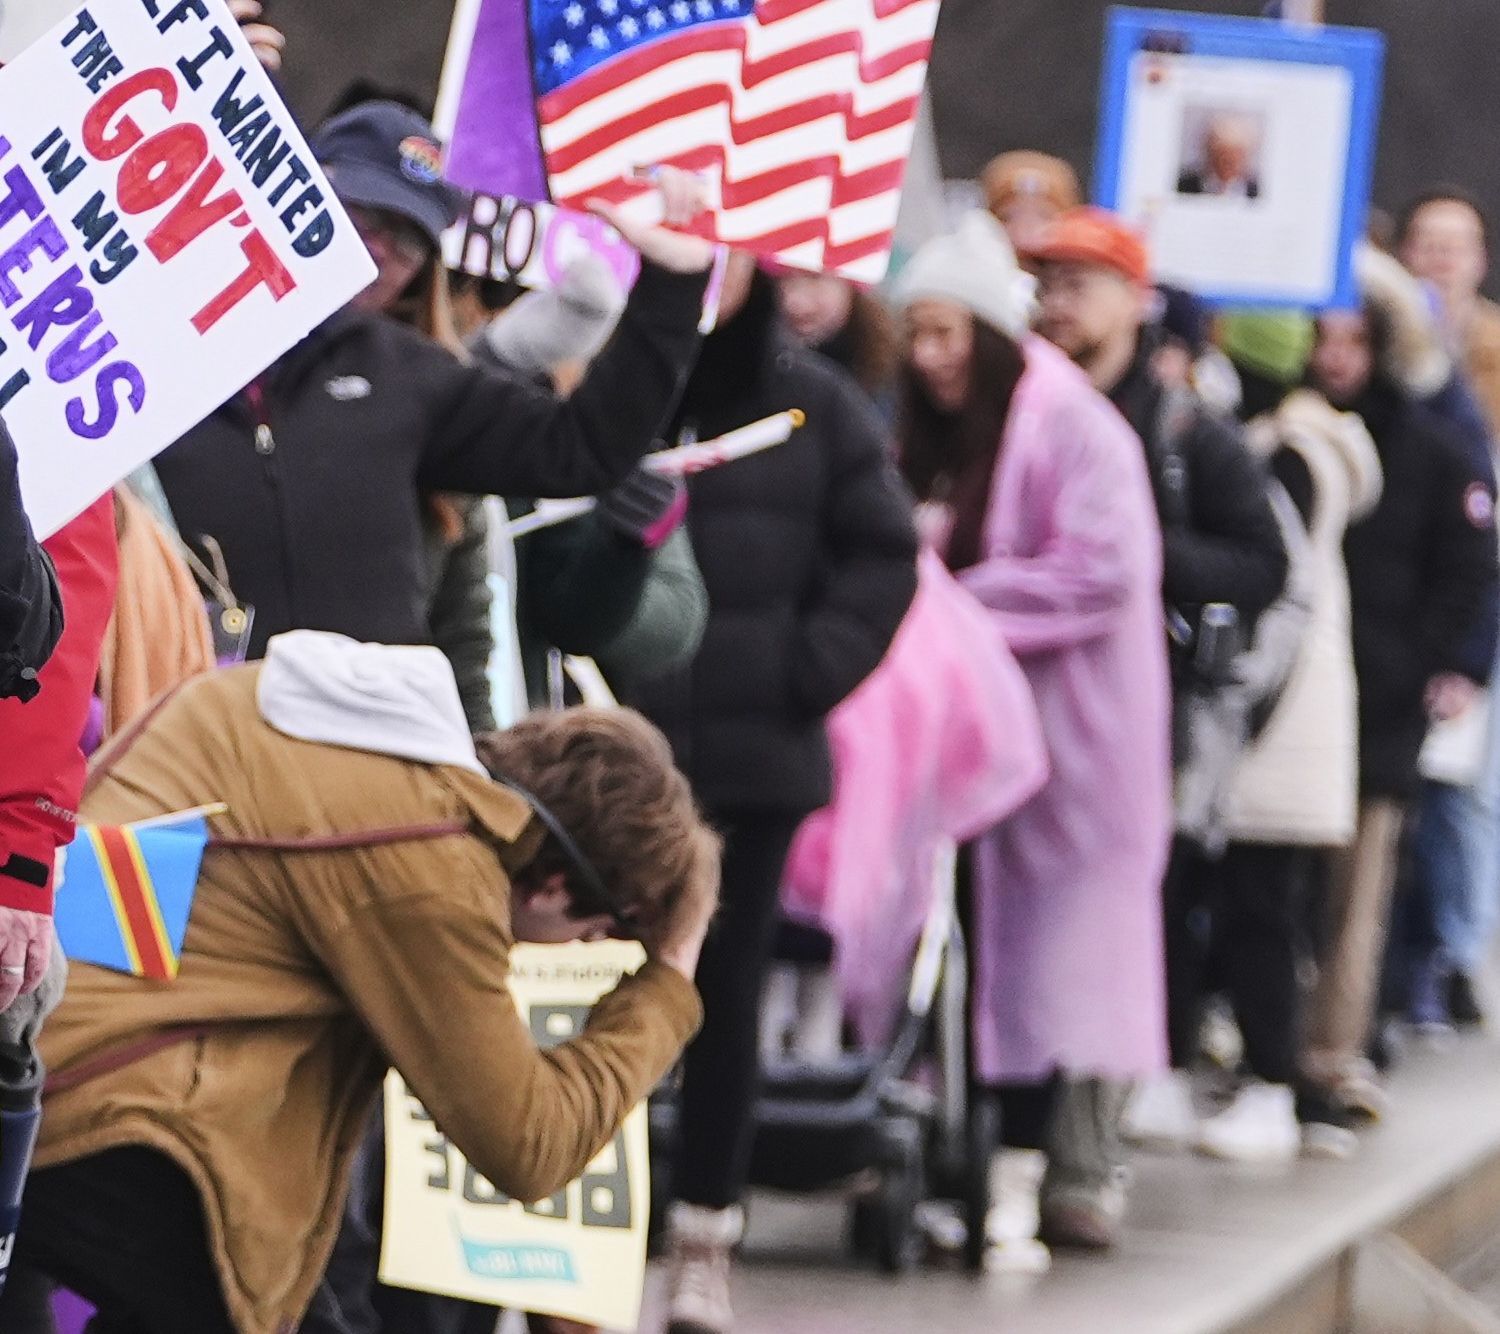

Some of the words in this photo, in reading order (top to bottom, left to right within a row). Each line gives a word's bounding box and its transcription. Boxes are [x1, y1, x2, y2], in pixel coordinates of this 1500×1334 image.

[61, 8, 123, 94] THE
[177, 25, 235, 92] I
[210, 66, 335, 258] WANTED
[30, 126, 87, 195] IN
[72, 189, 139, 285] MY
[82, 67, 297, 335] GOV'T
